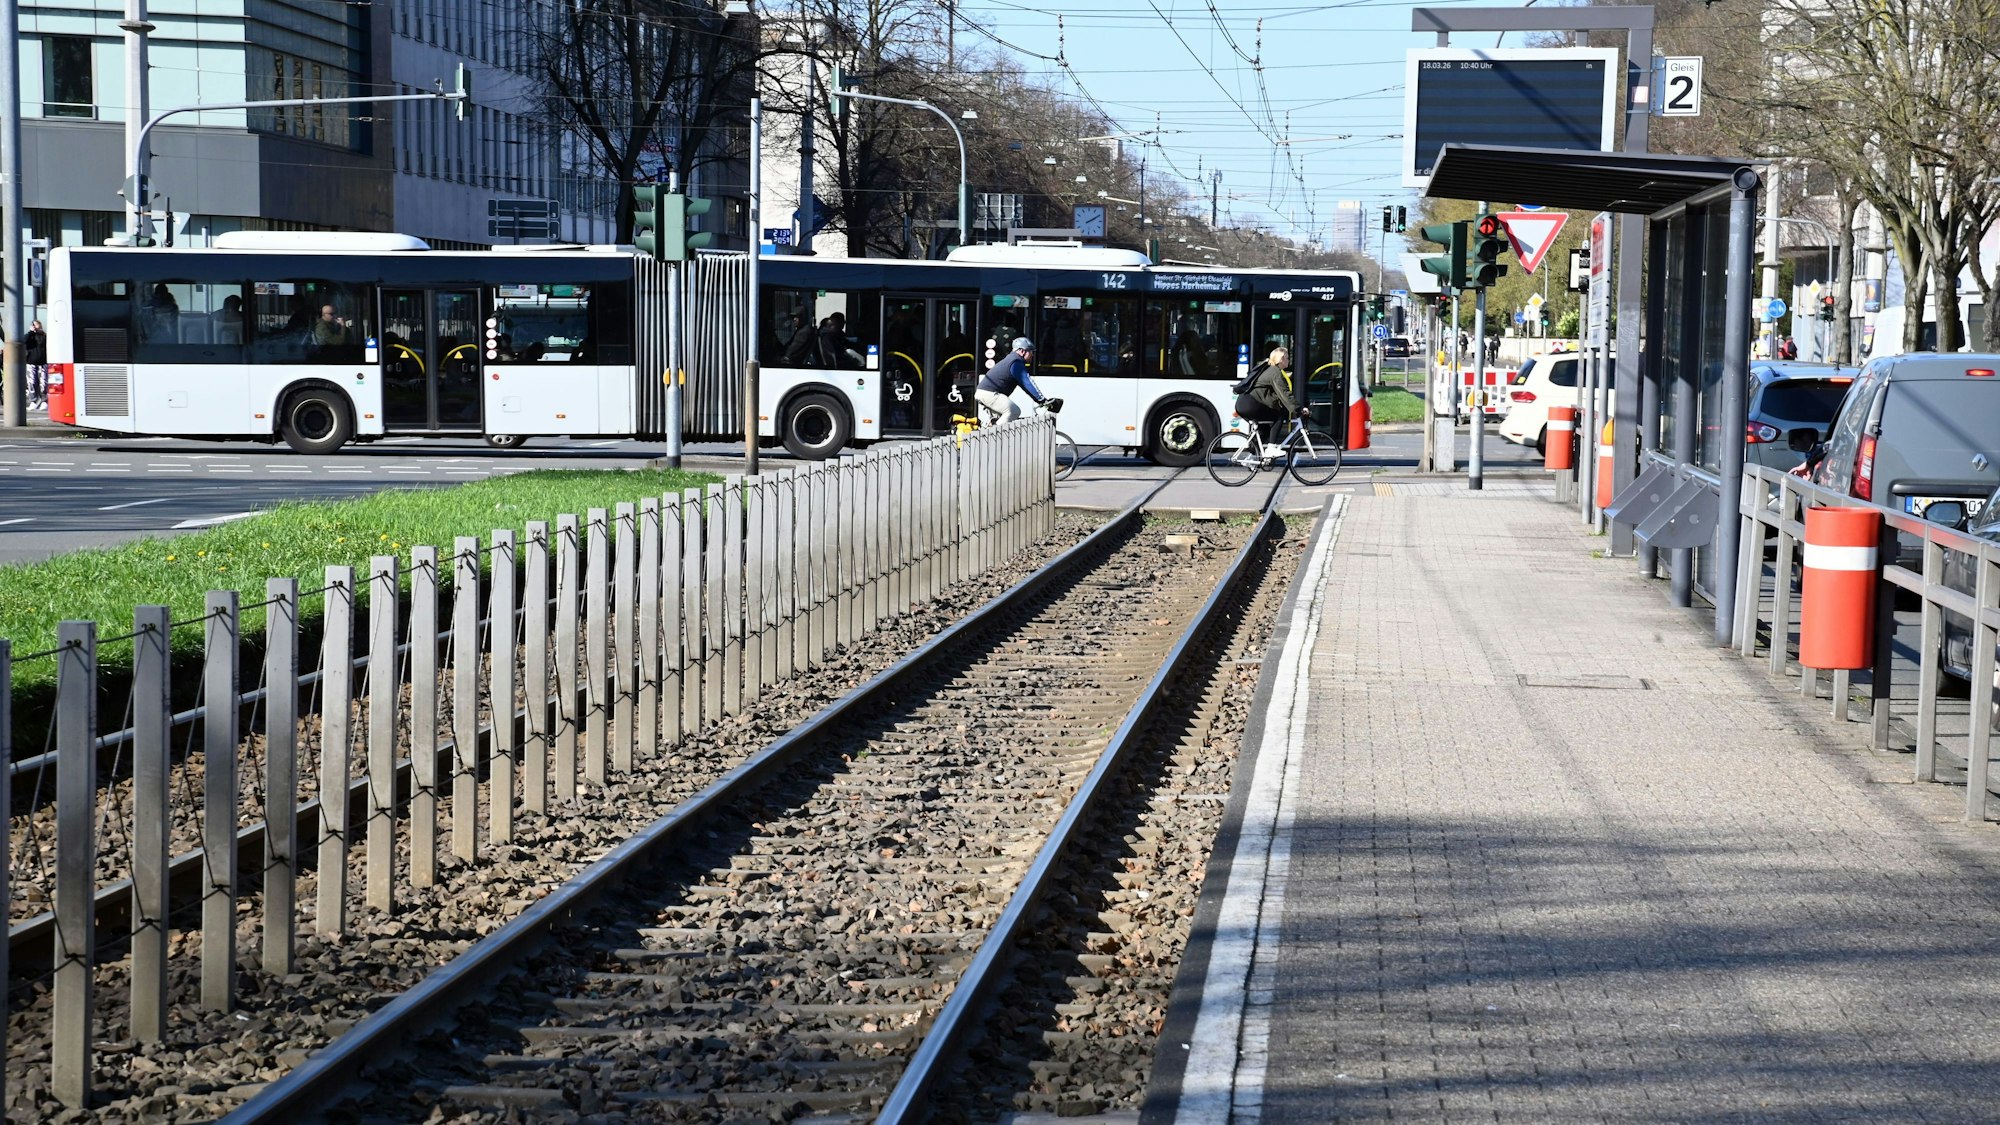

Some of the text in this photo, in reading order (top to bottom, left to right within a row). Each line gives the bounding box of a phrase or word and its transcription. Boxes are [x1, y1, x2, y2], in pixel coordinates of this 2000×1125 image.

[1671, 63, 1694, 71] Gleis
[1668, 76, 1693, 109] 2
[1102, 273, 1126, 288] 142
